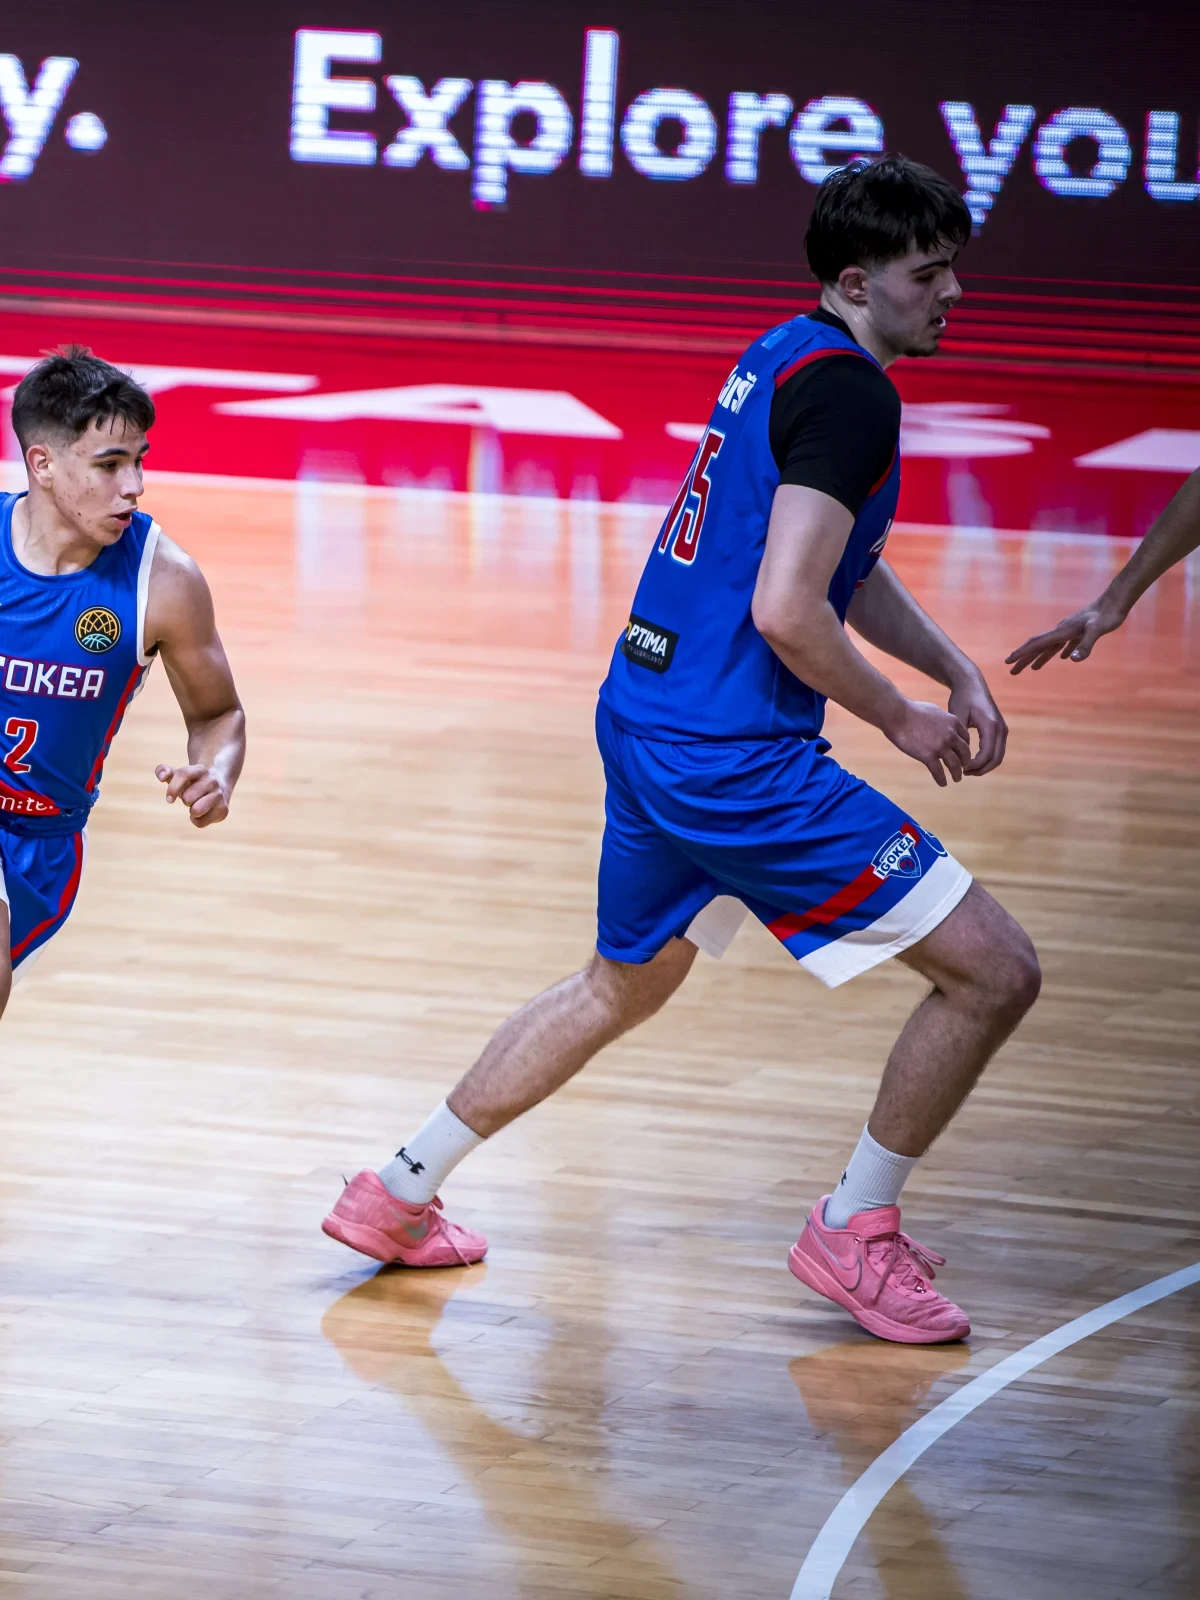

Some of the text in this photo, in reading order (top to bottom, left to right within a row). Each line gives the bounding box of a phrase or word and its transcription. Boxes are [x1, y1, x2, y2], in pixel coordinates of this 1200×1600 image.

[289, 26, 886, 210] Explore
[3, 717, 39, 774] 2
[876, 835, 915, 877] IGOKEA
